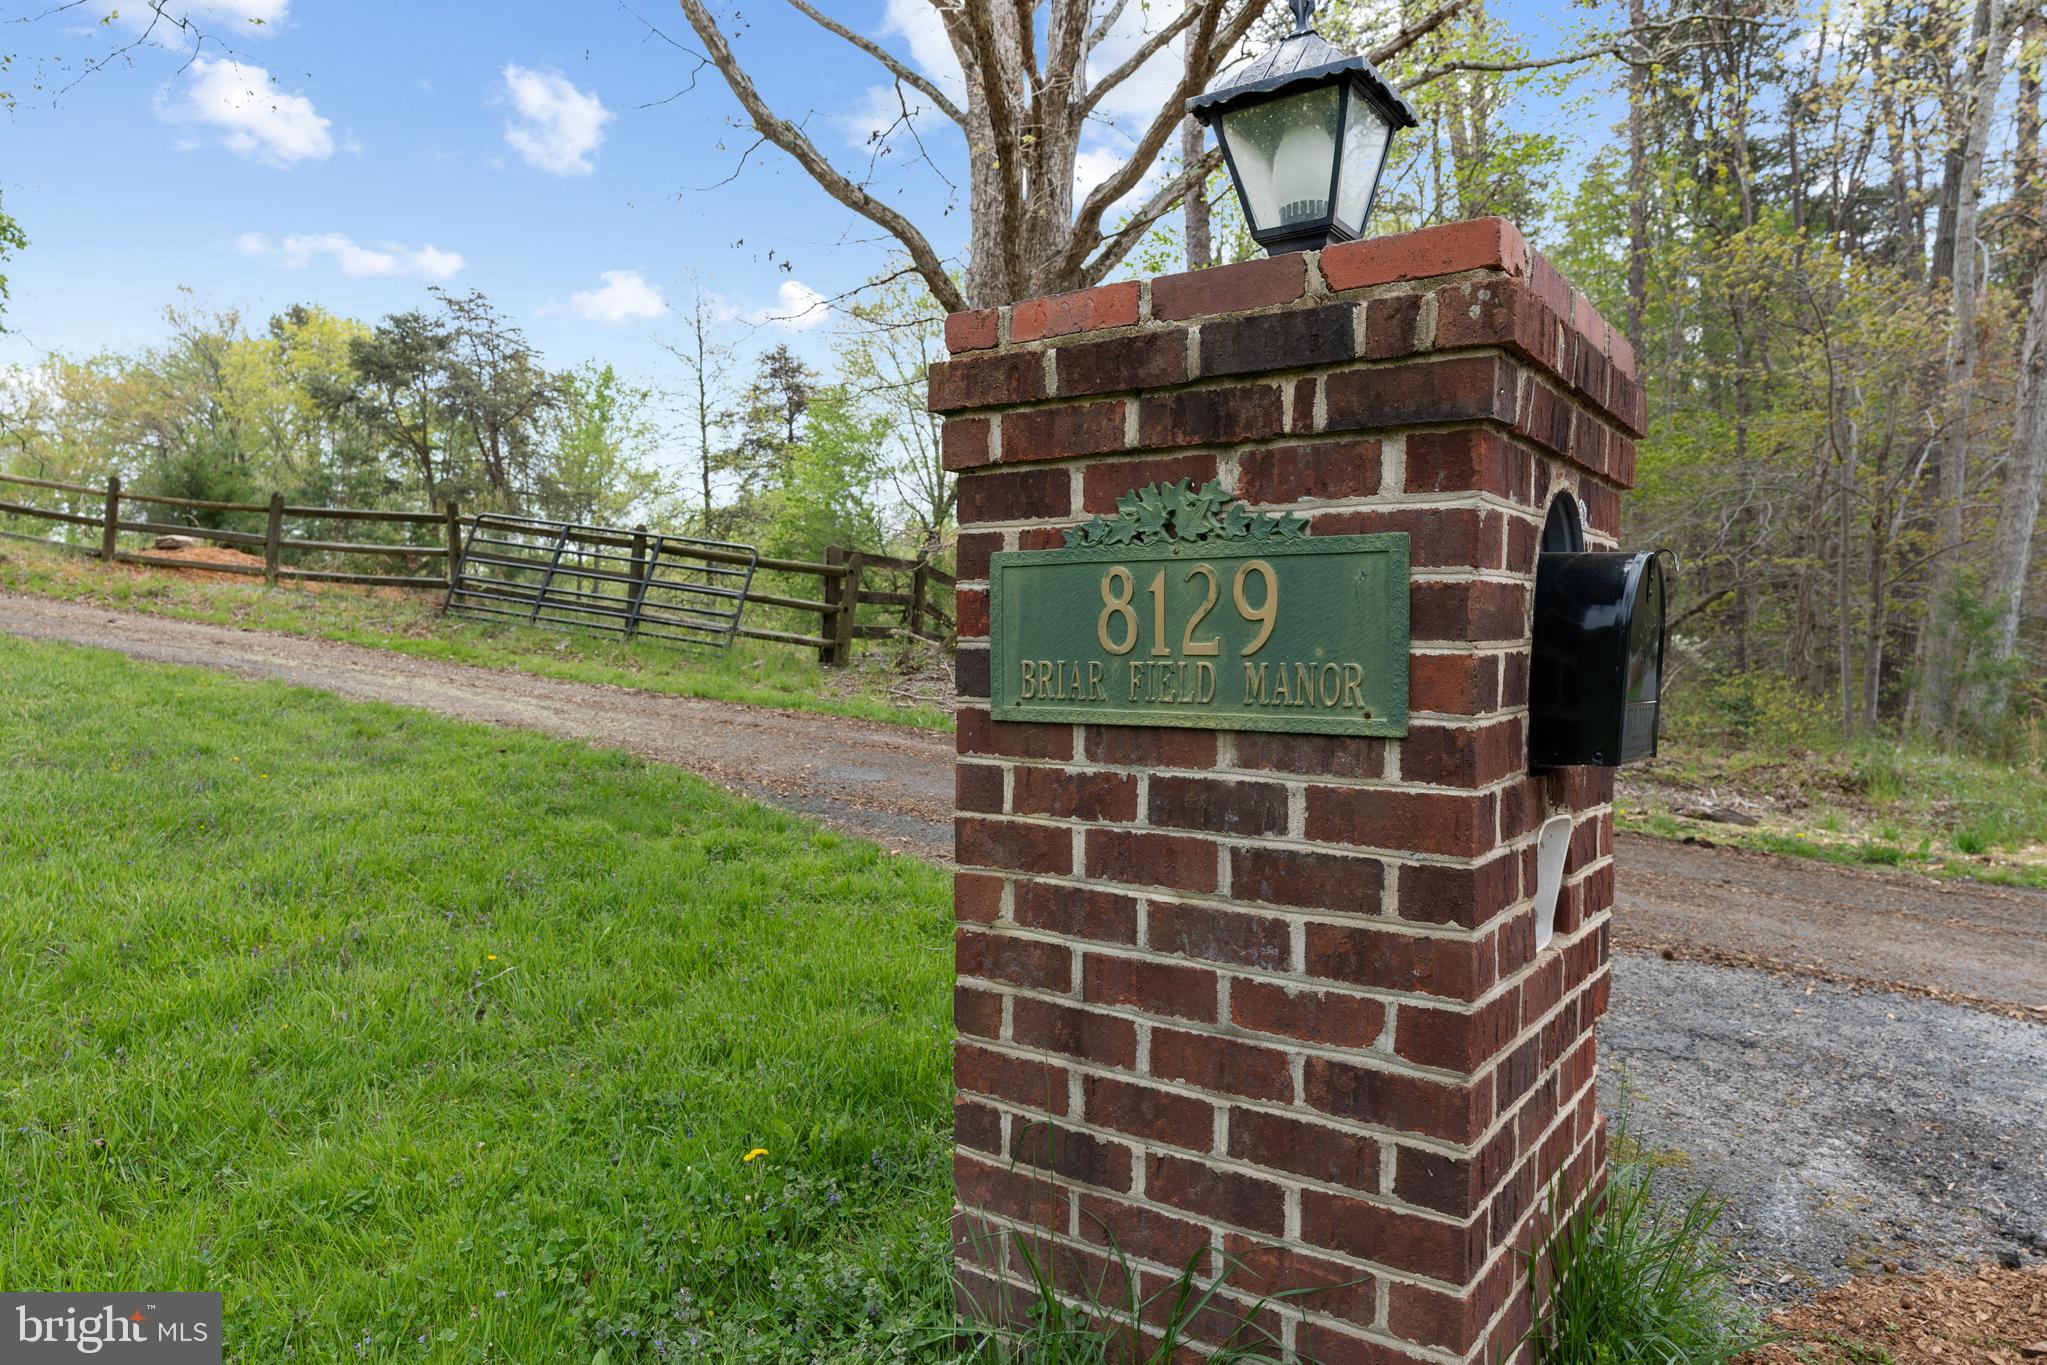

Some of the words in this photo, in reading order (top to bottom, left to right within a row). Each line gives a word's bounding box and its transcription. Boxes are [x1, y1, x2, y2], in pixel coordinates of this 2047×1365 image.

[1097, 559, 1279, 656] 8129
[1020, 660, 1106, 701] BRIAR
[1129, 660, 1217, 704] FIELD
[1243, 662, 1366, 709] MANOR
